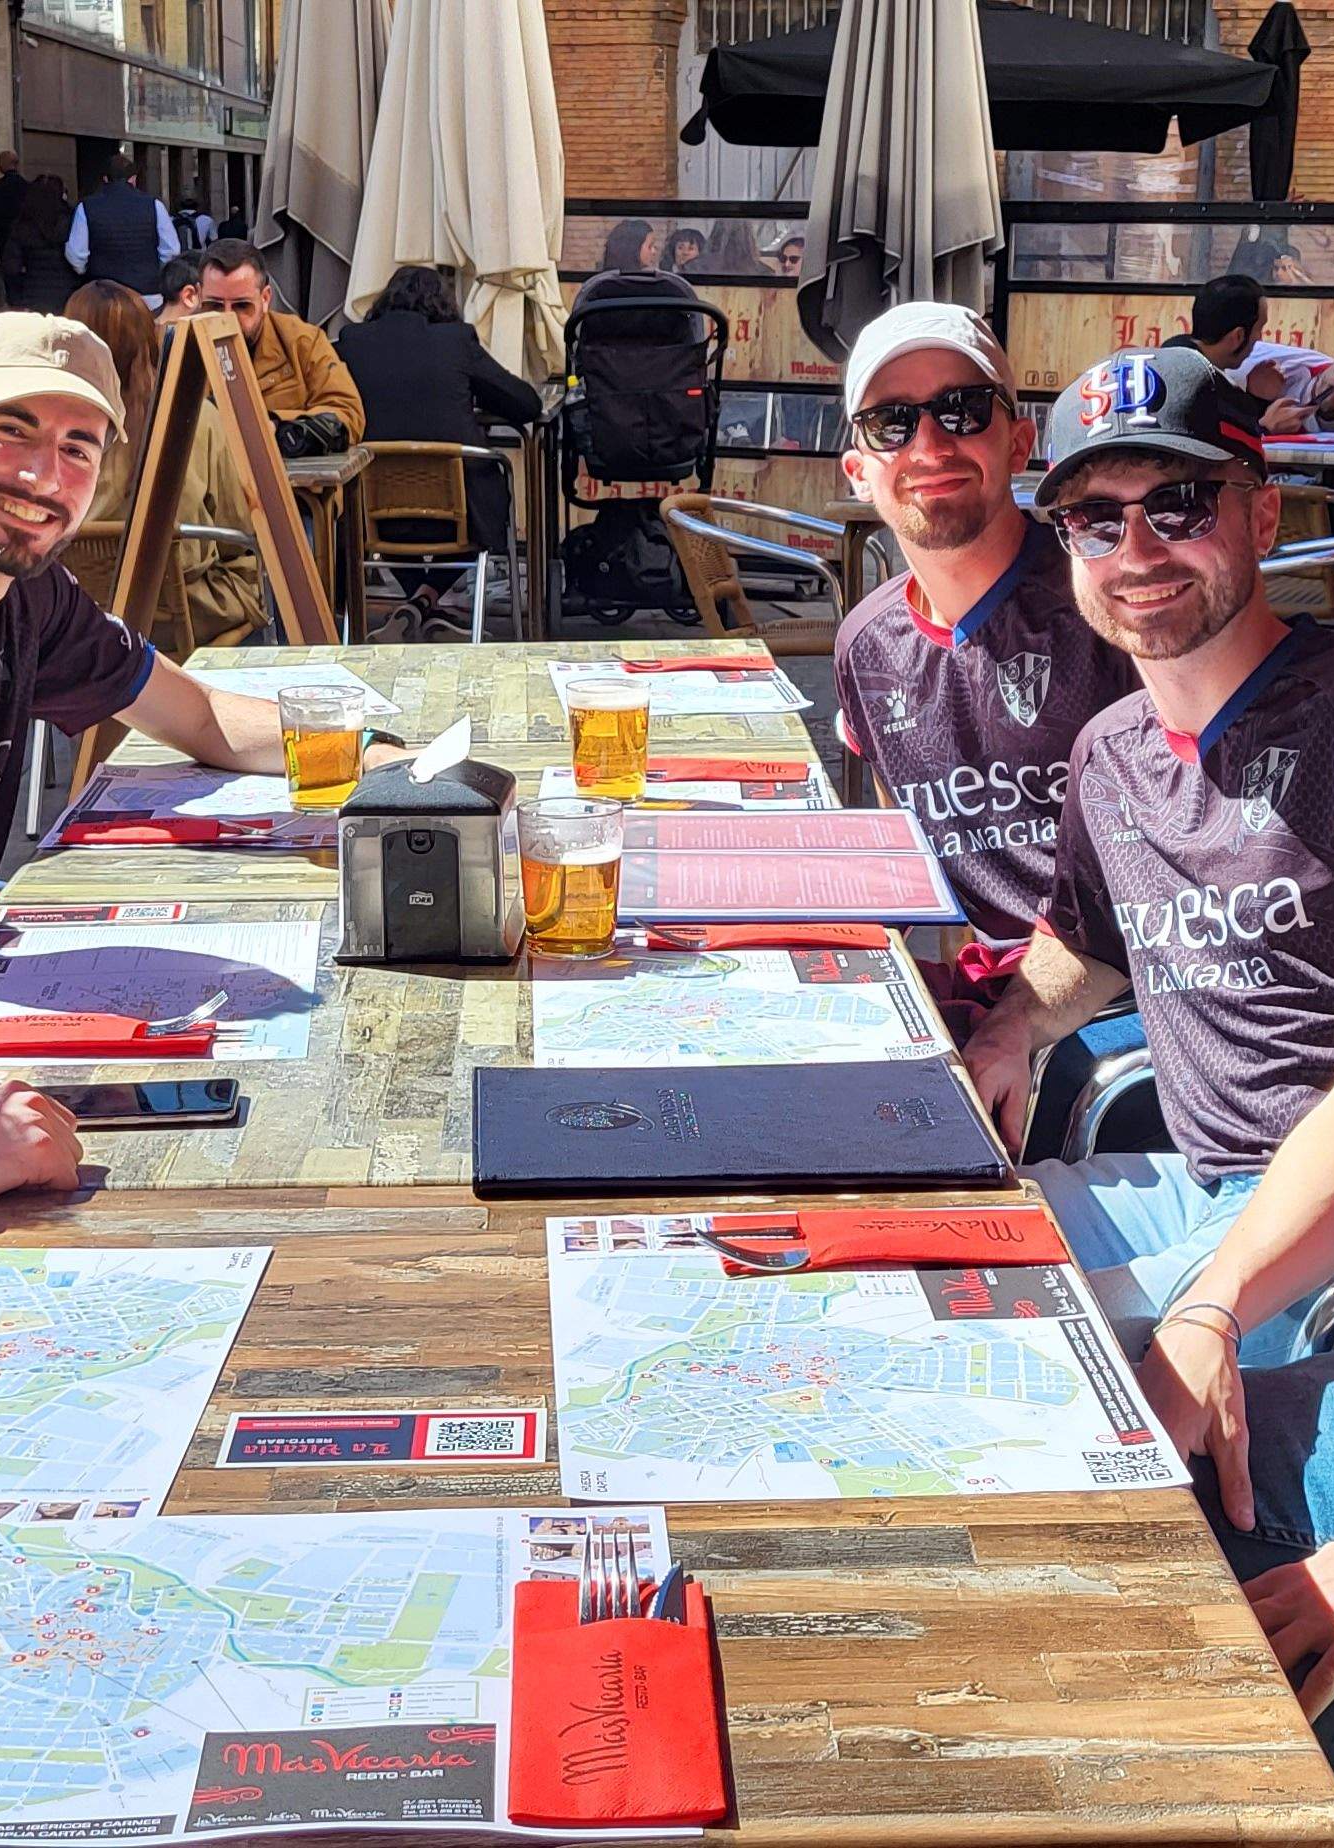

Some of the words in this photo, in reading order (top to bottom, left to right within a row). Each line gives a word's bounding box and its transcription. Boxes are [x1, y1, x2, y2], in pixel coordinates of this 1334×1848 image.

[883, 717, 918, 735] KELME
[1113, 876, 1315, 951] Huesca
[345, 1770, 399, 1782] RESTO
[409, 1768, 445, 1779] BAR
[101, 1818, 161, 1828] CARNES
[38, 1830, 88, 1838] CARTA
[89, 1829, 110, 1837] DE
[111, 1826, 158, 1836] VINOS
